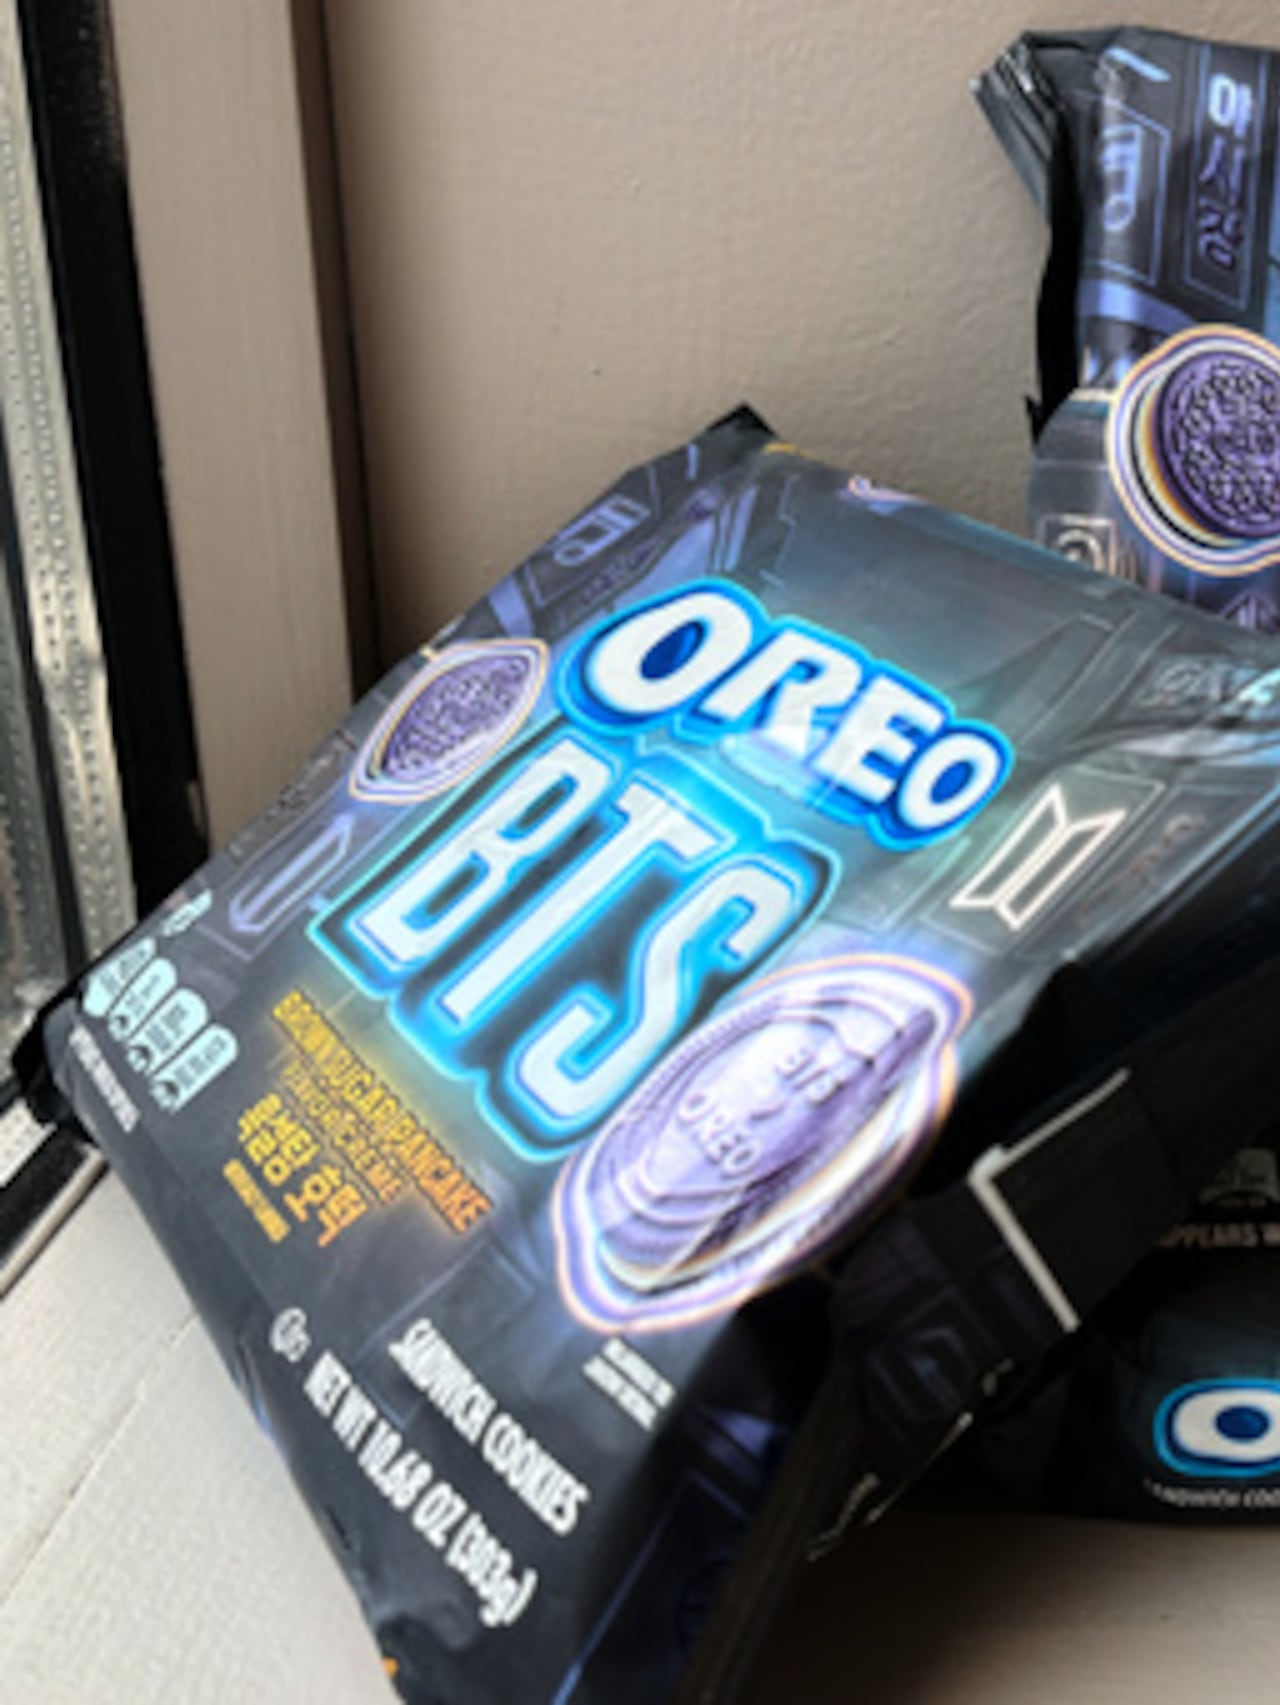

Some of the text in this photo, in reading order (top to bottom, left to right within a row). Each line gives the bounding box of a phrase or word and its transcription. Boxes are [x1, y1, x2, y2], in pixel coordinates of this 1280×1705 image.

[586, 590, 1003, 832] OREO
[349, 732, 801, 1121] BTS
[378, 1112, 494, 1234] PANCAKE
[303, 1349, 353, 1418] NET
[331, 1383, 379, 1452] WT
[357, 1417, 434, 1511] 10.68
[411, 1482, 469, 1549] OZ
[481, 1412, 591, 1536] COOKIES
